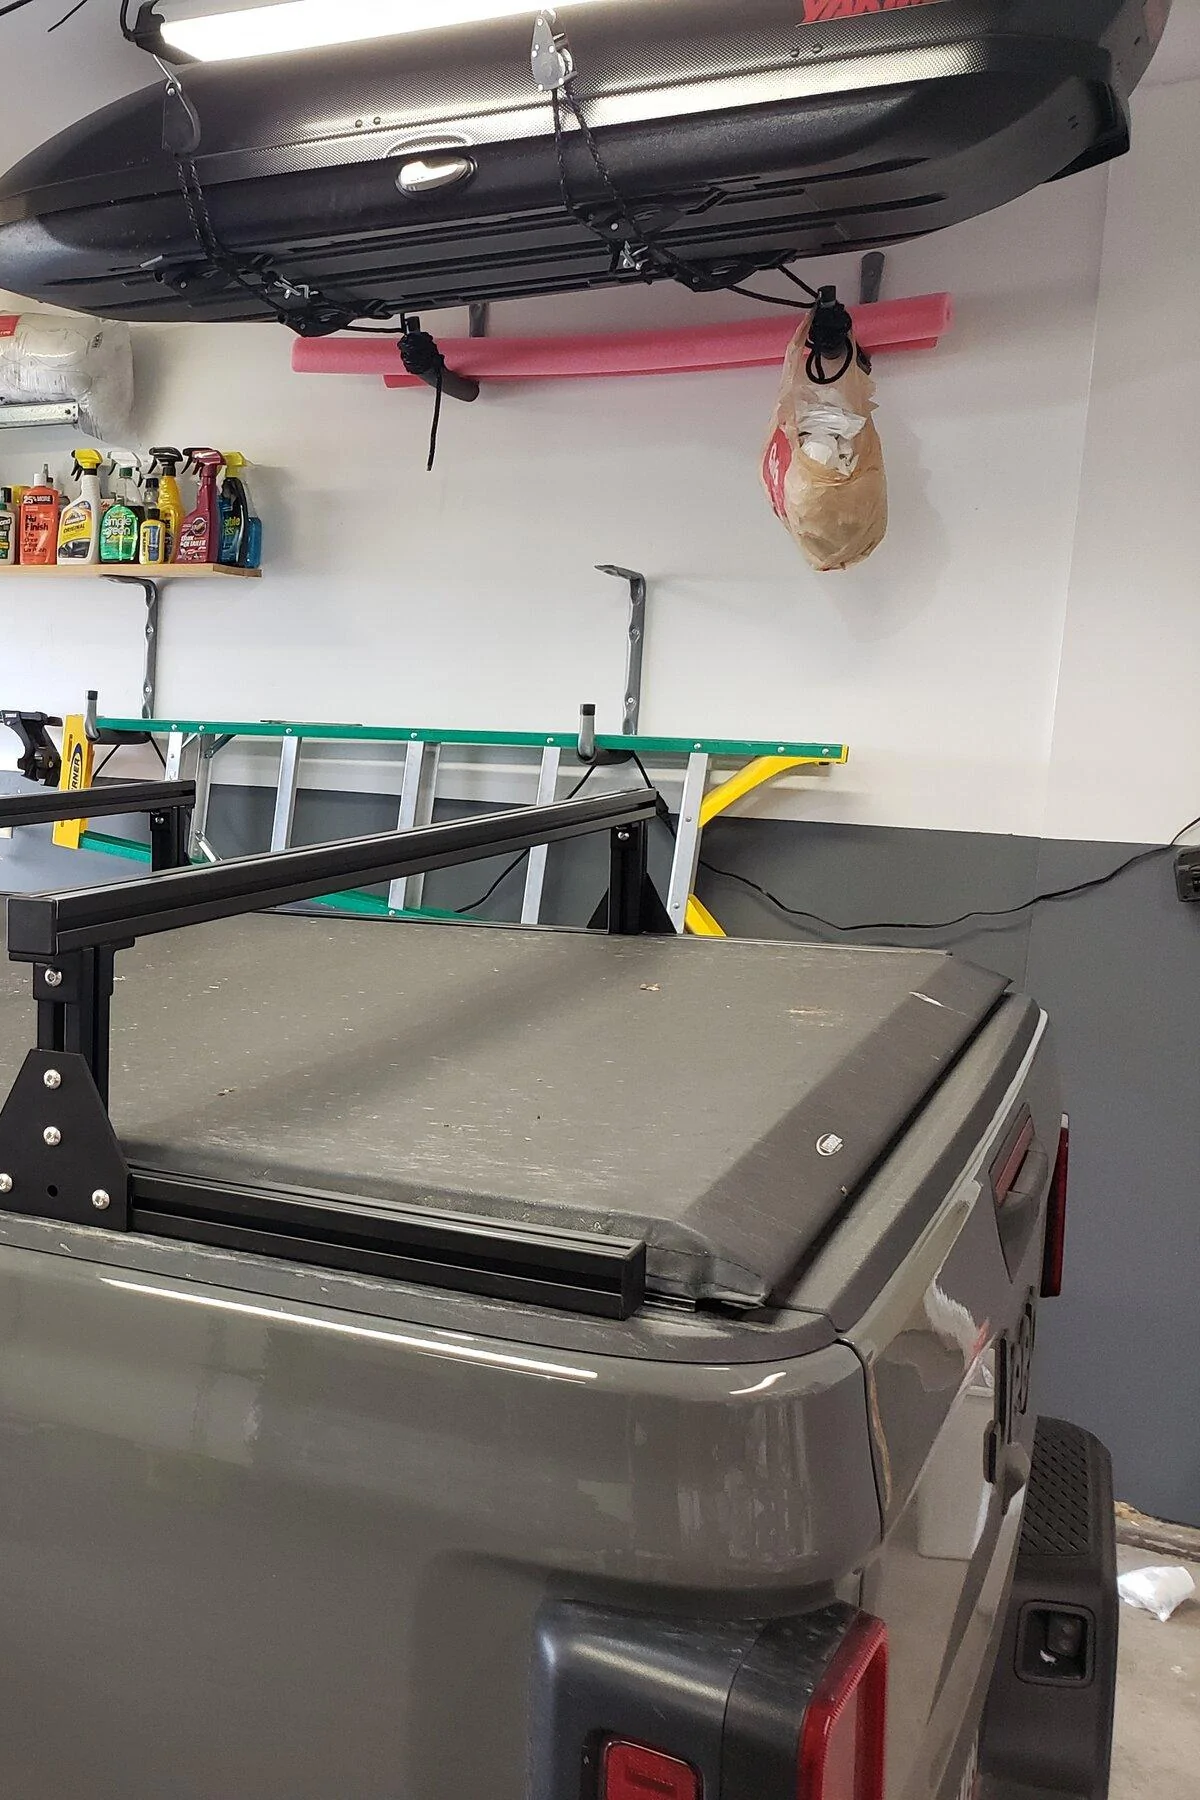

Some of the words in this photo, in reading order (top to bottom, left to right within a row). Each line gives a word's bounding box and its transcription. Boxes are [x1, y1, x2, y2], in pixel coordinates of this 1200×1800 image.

[104, 515, 132, 528] simple
[63, 523, 85, 533] ORIGINAL
[105, 527, 131, 539] green
